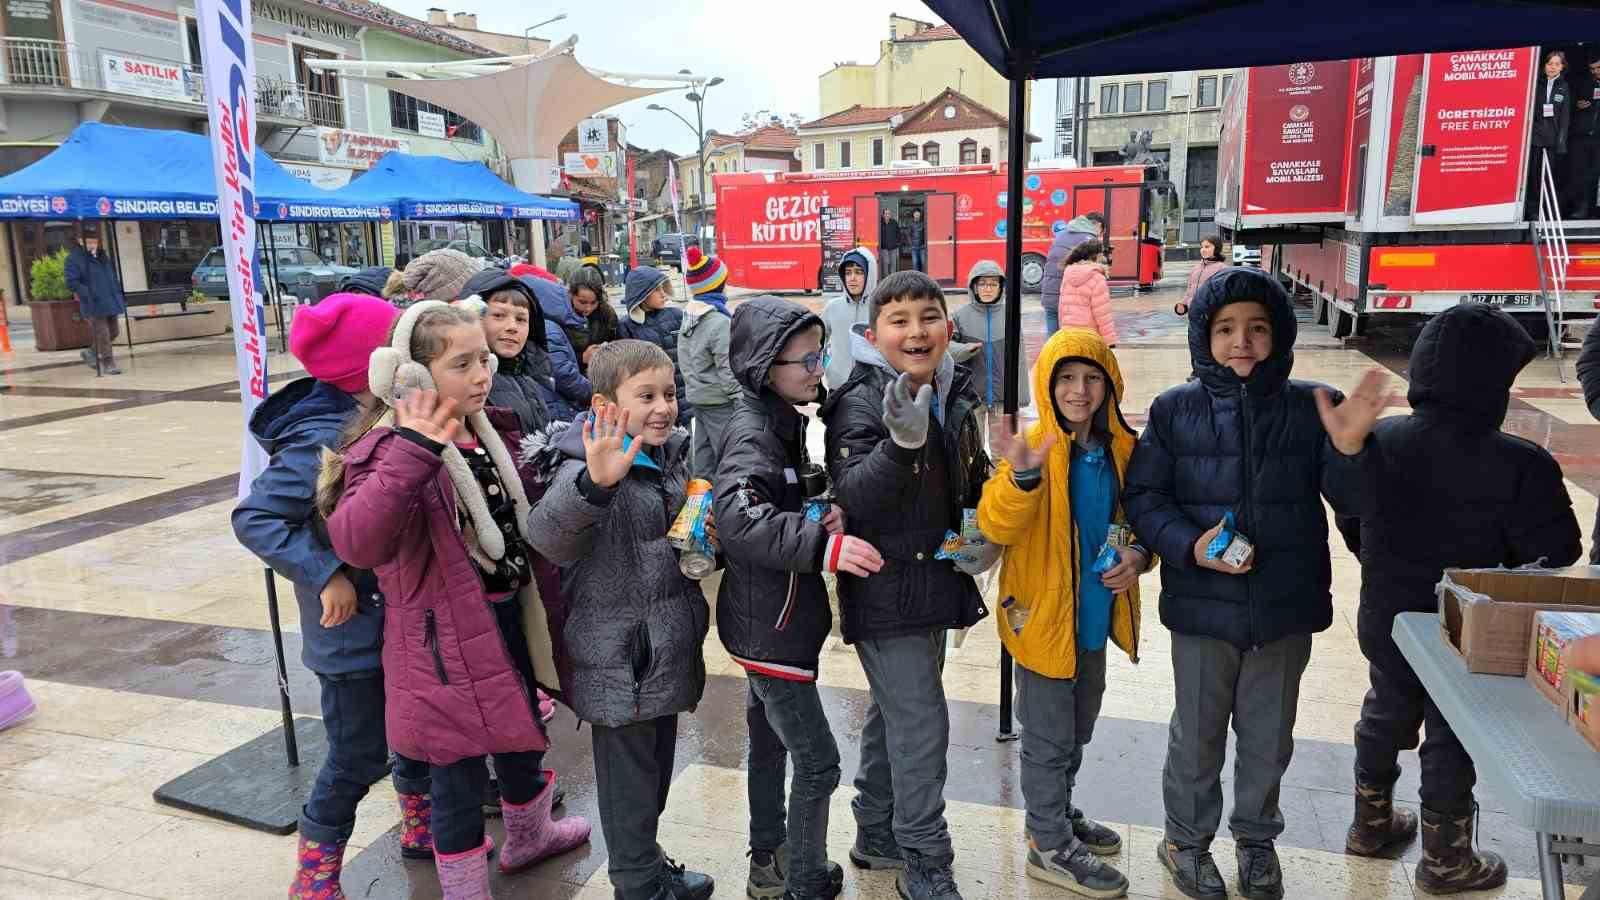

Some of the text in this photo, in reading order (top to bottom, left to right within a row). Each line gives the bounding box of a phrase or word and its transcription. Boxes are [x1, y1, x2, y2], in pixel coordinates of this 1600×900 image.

[123, 61, 179, 81] SATILIK
[1438, 107, 1516, 119] ÜCRETSİZDİR
[1440, 120, 1511, 131] FREE ENTRY
[217, 98, 241, 193] Kalbi
[114, 199, 174, 214] SINDIRGI
[289, 206, 332, 217] SINDIRGI
[766, 190, 830, 221] GEZİCİ
[1490, 295, 1508, 305] AAF
[1514, 295, 1529, 305] 915
